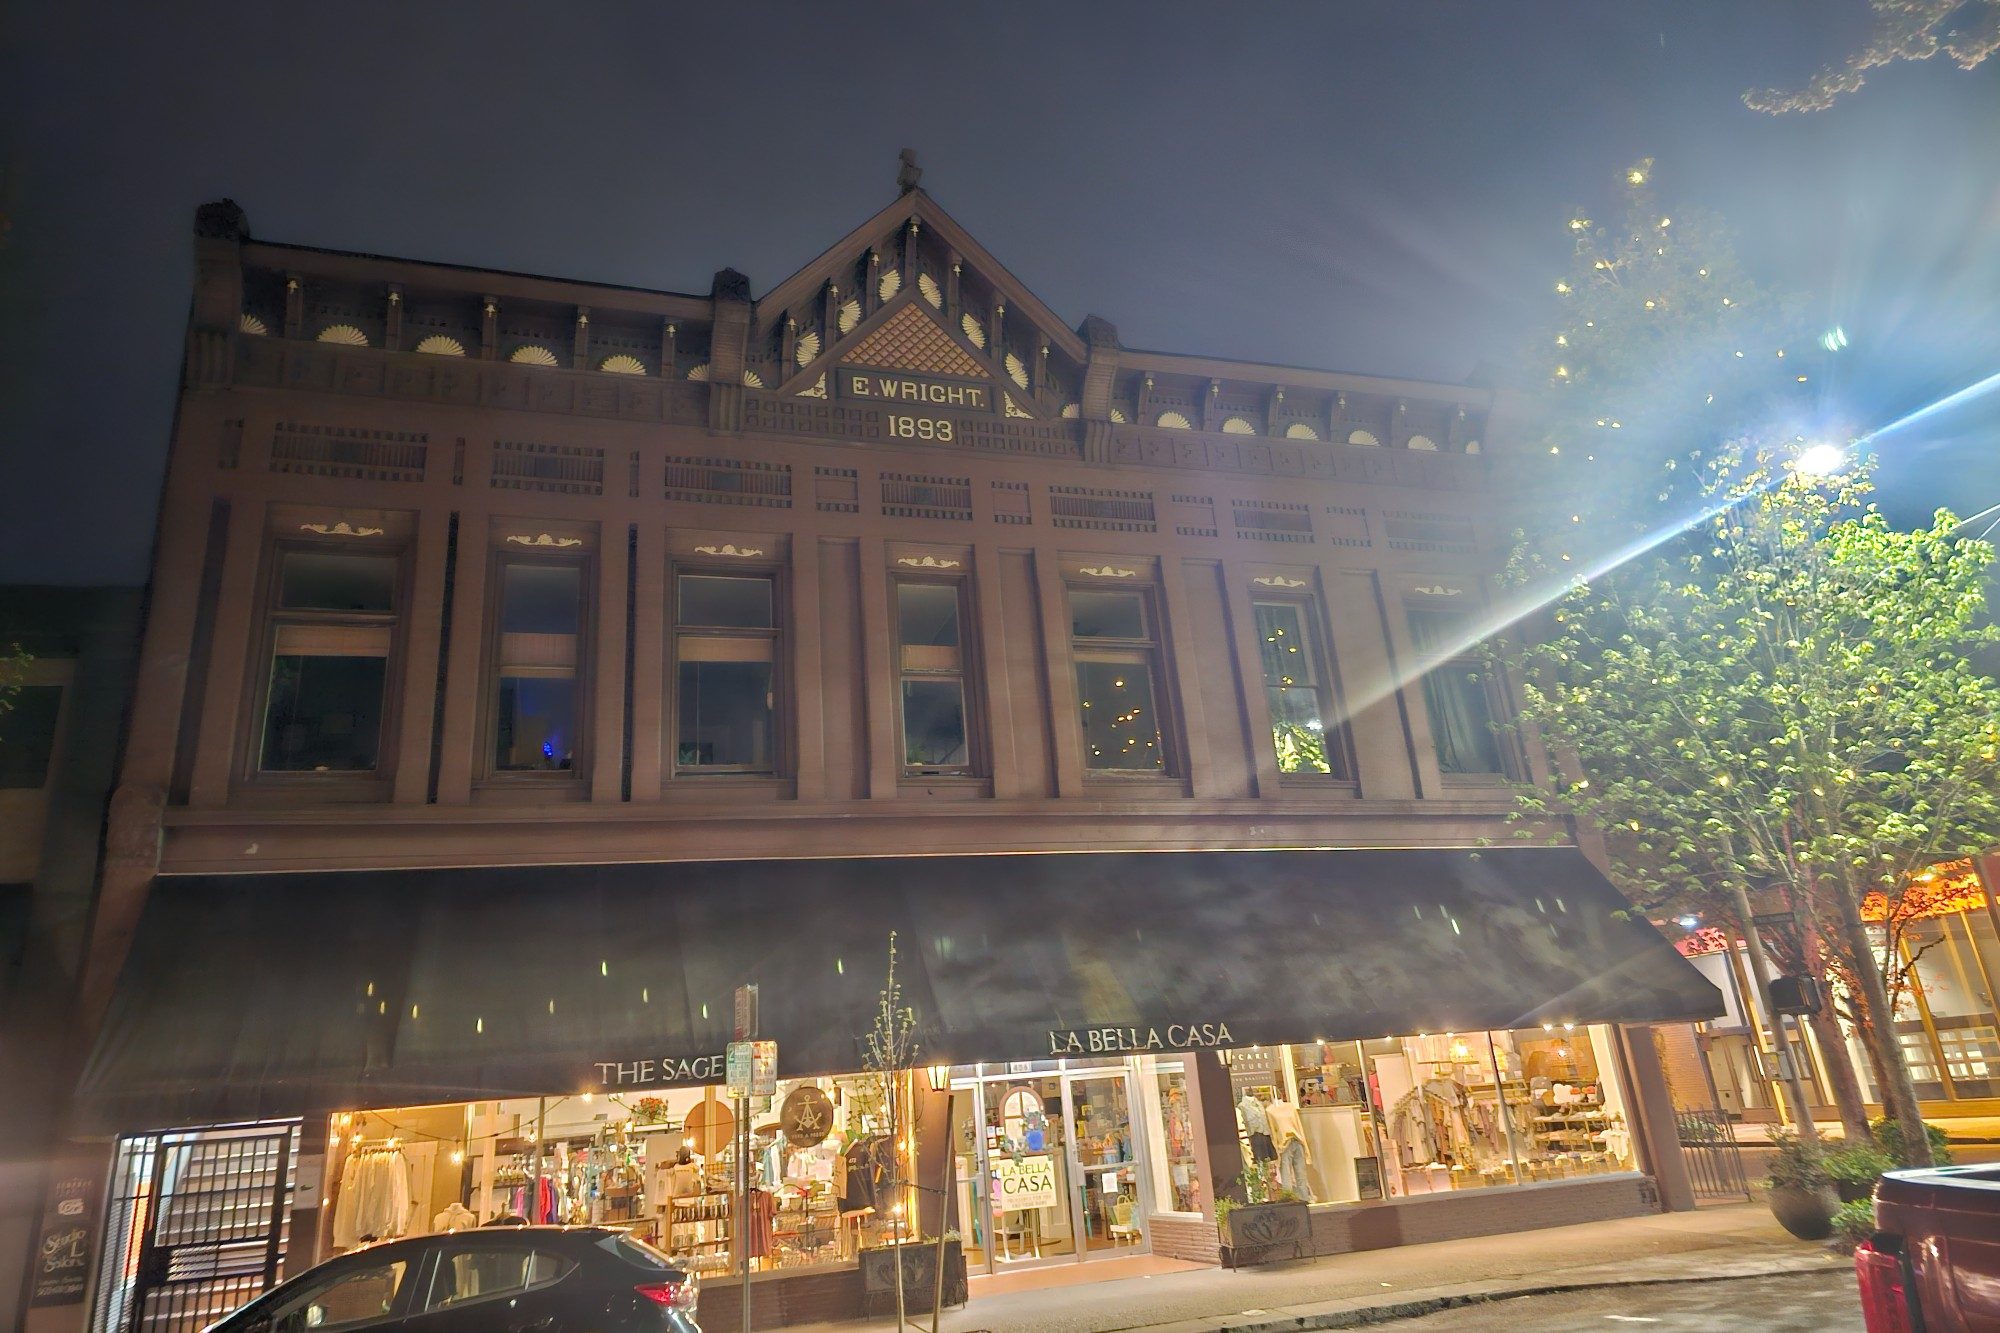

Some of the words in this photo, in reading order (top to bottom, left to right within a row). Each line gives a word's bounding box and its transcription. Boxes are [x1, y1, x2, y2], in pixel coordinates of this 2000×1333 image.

[887, 415, 953, 441] 1893
[1050, 1028, 1085, 1054] LA
[1088, 1025, 1164, 1051] BELLA
[1168, 1024, 1235, 1047] CASA
[595, 1060, 655, 1084] THE
[662, 1055, 724, 1079] SAGE
[1002, 1166, 1016, 1177] LA
[1019, 1163, 1051, 1175] BELLA
[1003, 1174, 1053, 1194] CASA
